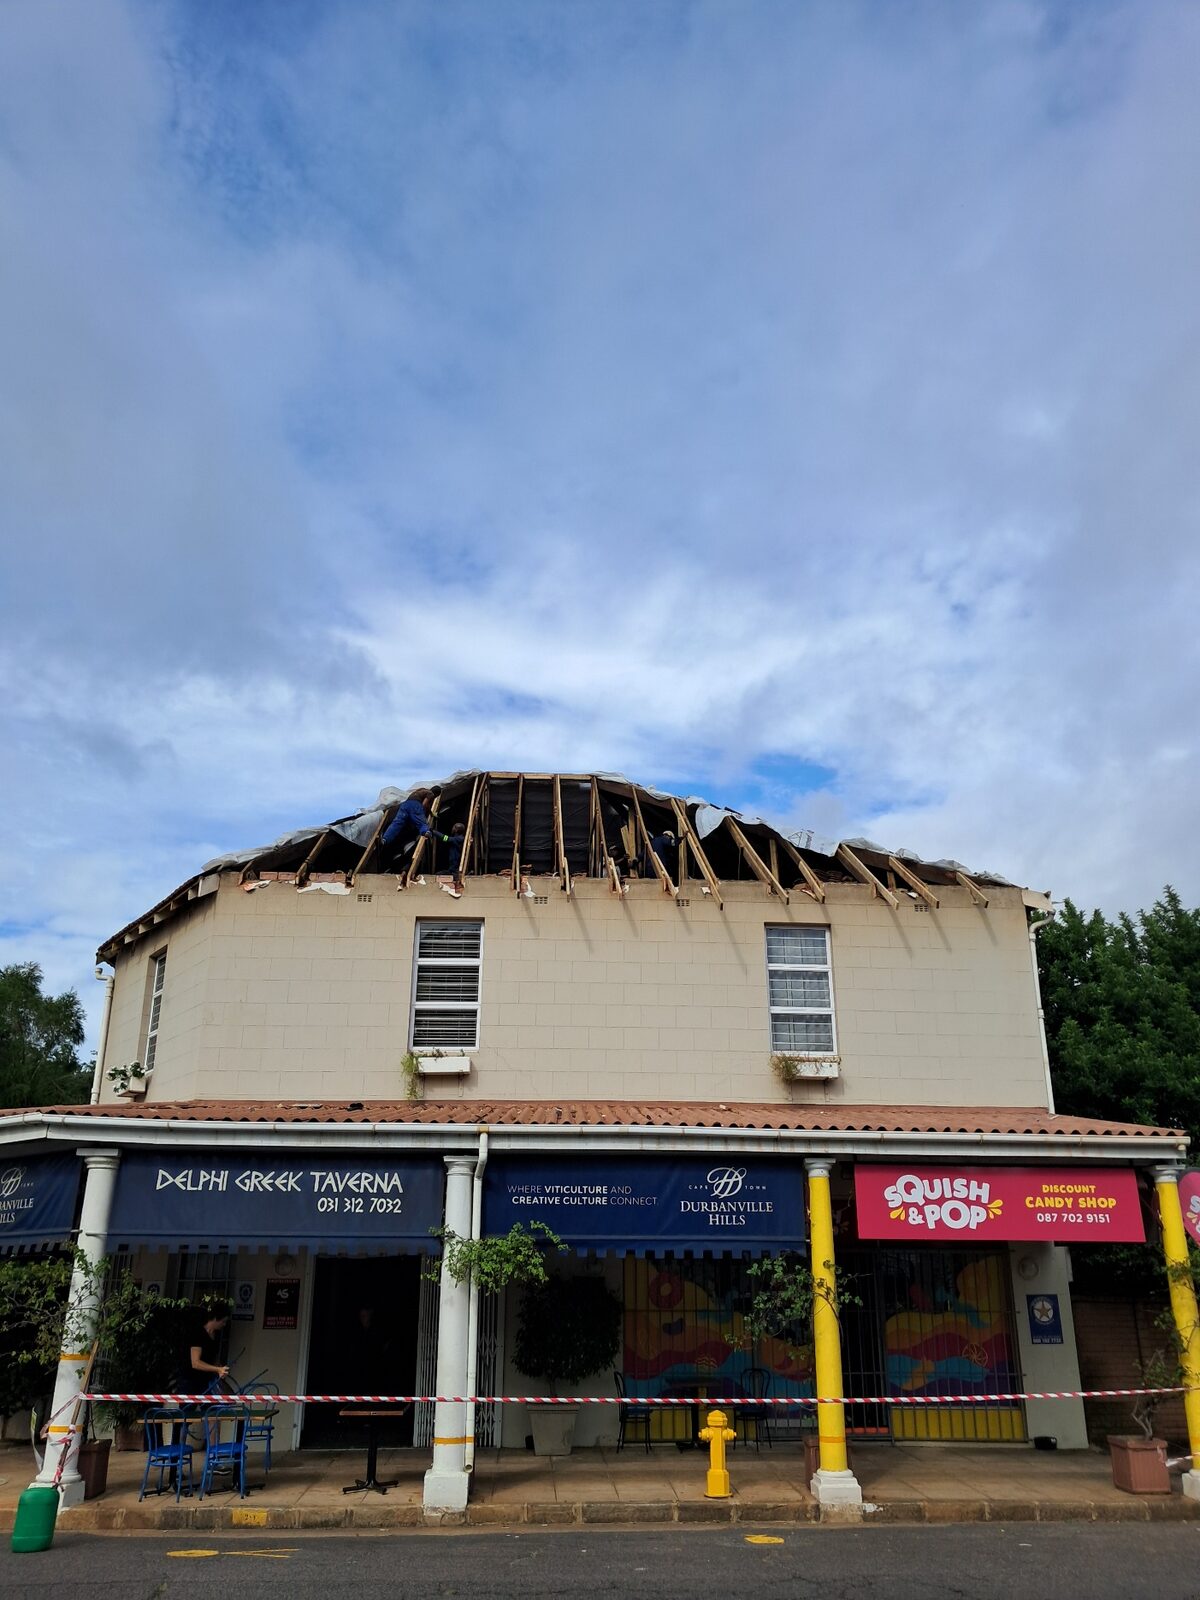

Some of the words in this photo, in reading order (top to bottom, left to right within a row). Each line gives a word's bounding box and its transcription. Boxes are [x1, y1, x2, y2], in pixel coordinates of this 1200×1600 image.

[156, 1169, 229, 1191] DELPHI
[234, 1170, 304, 1192] GREEK
[310, 1171, 404, 1193] TAVERNA
[507, 1185, 542, 1194] WHERE
[544, 1185, 608, 1194] VITICULTURE
[610, 1185, 632, 1194] AND
[883, 1174, 990, 1208] SQUISH
[1042, 1184, 1096, 1194] DISCOUNT
[317, 1197, 339, 1213] 031
[343, 1197, 364, 1213] 312
[369, 1198, 402, 1213] 7032
[511, 1196, 560, 1205] CREATIVE
[562, 1196, 608, 1205] CULTURE
[680, 1200, 774, 1212] DURBANVILLE
[1025, 1196, 1074, 1209] CANDY
[1078, 1197, 1117, 1209] SHOP
[708, 1214, 746, 1226] HILLS
[1036, 1212, 1058, 1223] 087
[1061, 1213, 1084, 1223] 702
[1086, 1213, 1110, 1223] 9151
